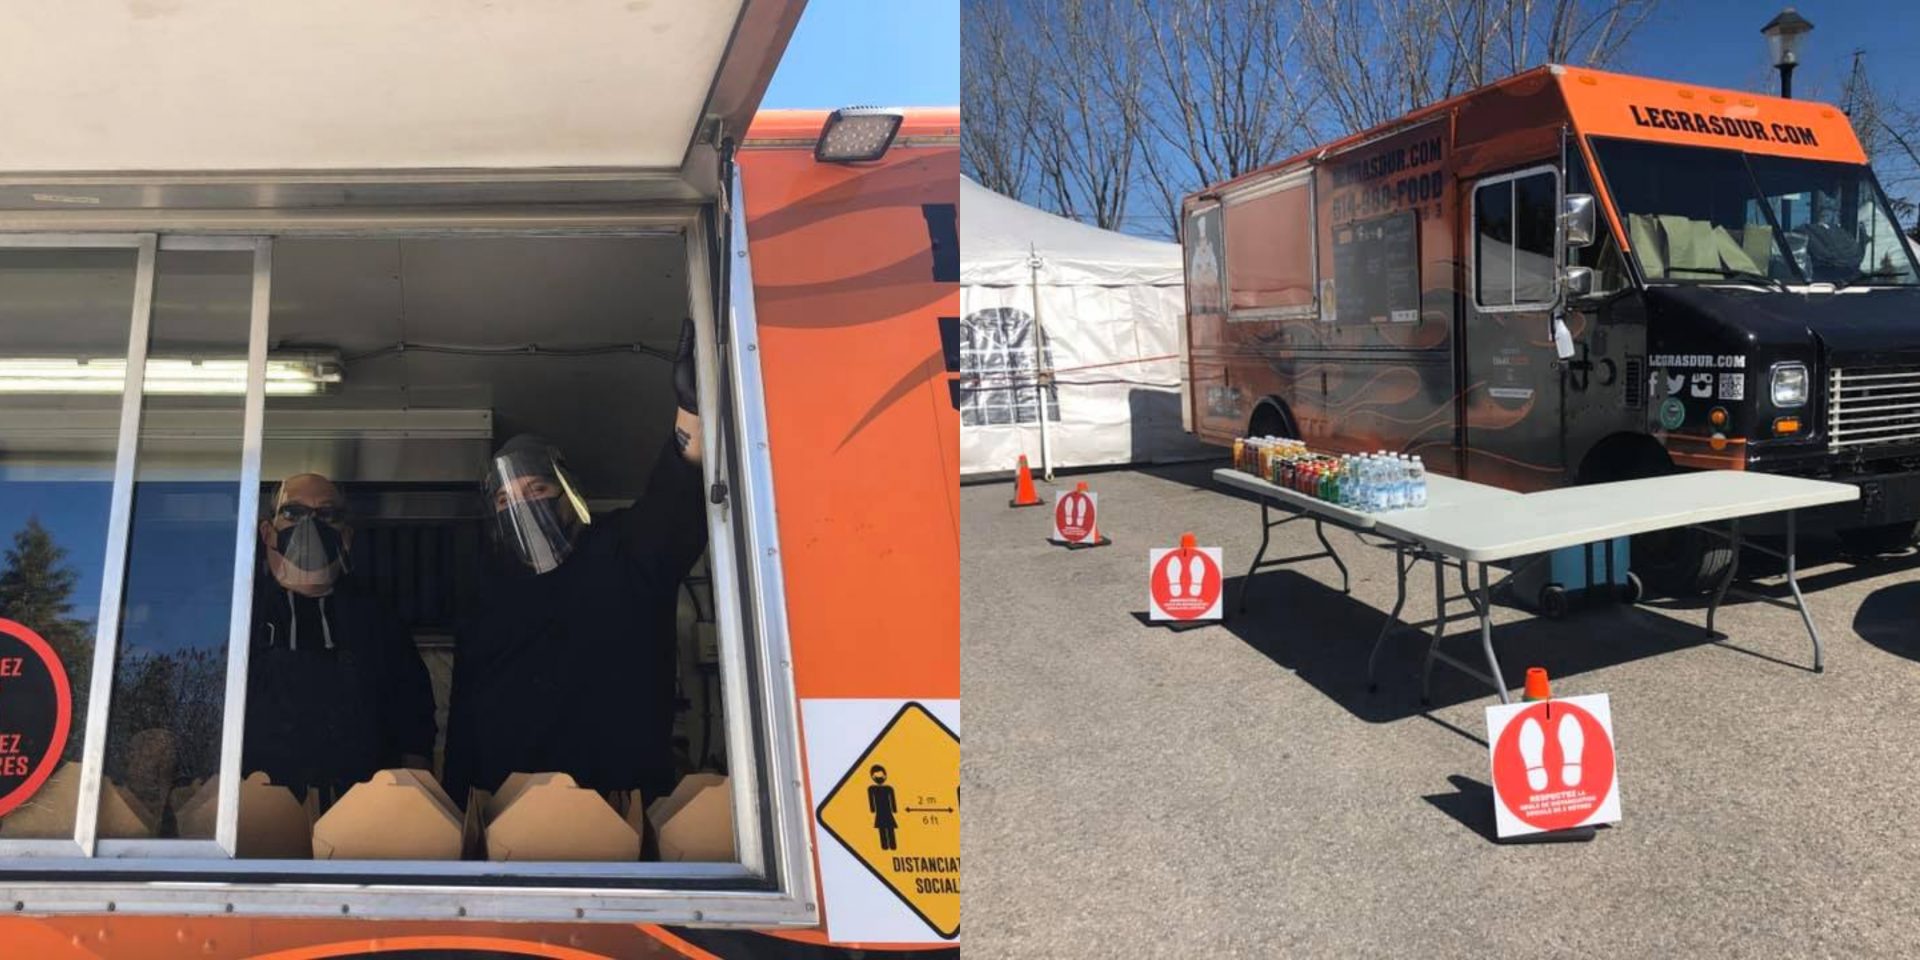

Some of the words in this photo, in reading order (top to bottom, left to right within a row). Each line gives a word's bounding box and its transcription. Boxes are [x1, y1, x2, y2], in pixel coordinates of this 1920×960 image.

[1629, 104, 1819, 147] LEGRASDUR.COM
[1649, 354, 1746, 368] LEGRASDUR.COM
[917, 796, 923, 805] 2
[922, 815, 929, 825] 6
[930, 815, 939, 825] ft
[915, 877, 960, 894] SOCIAL
